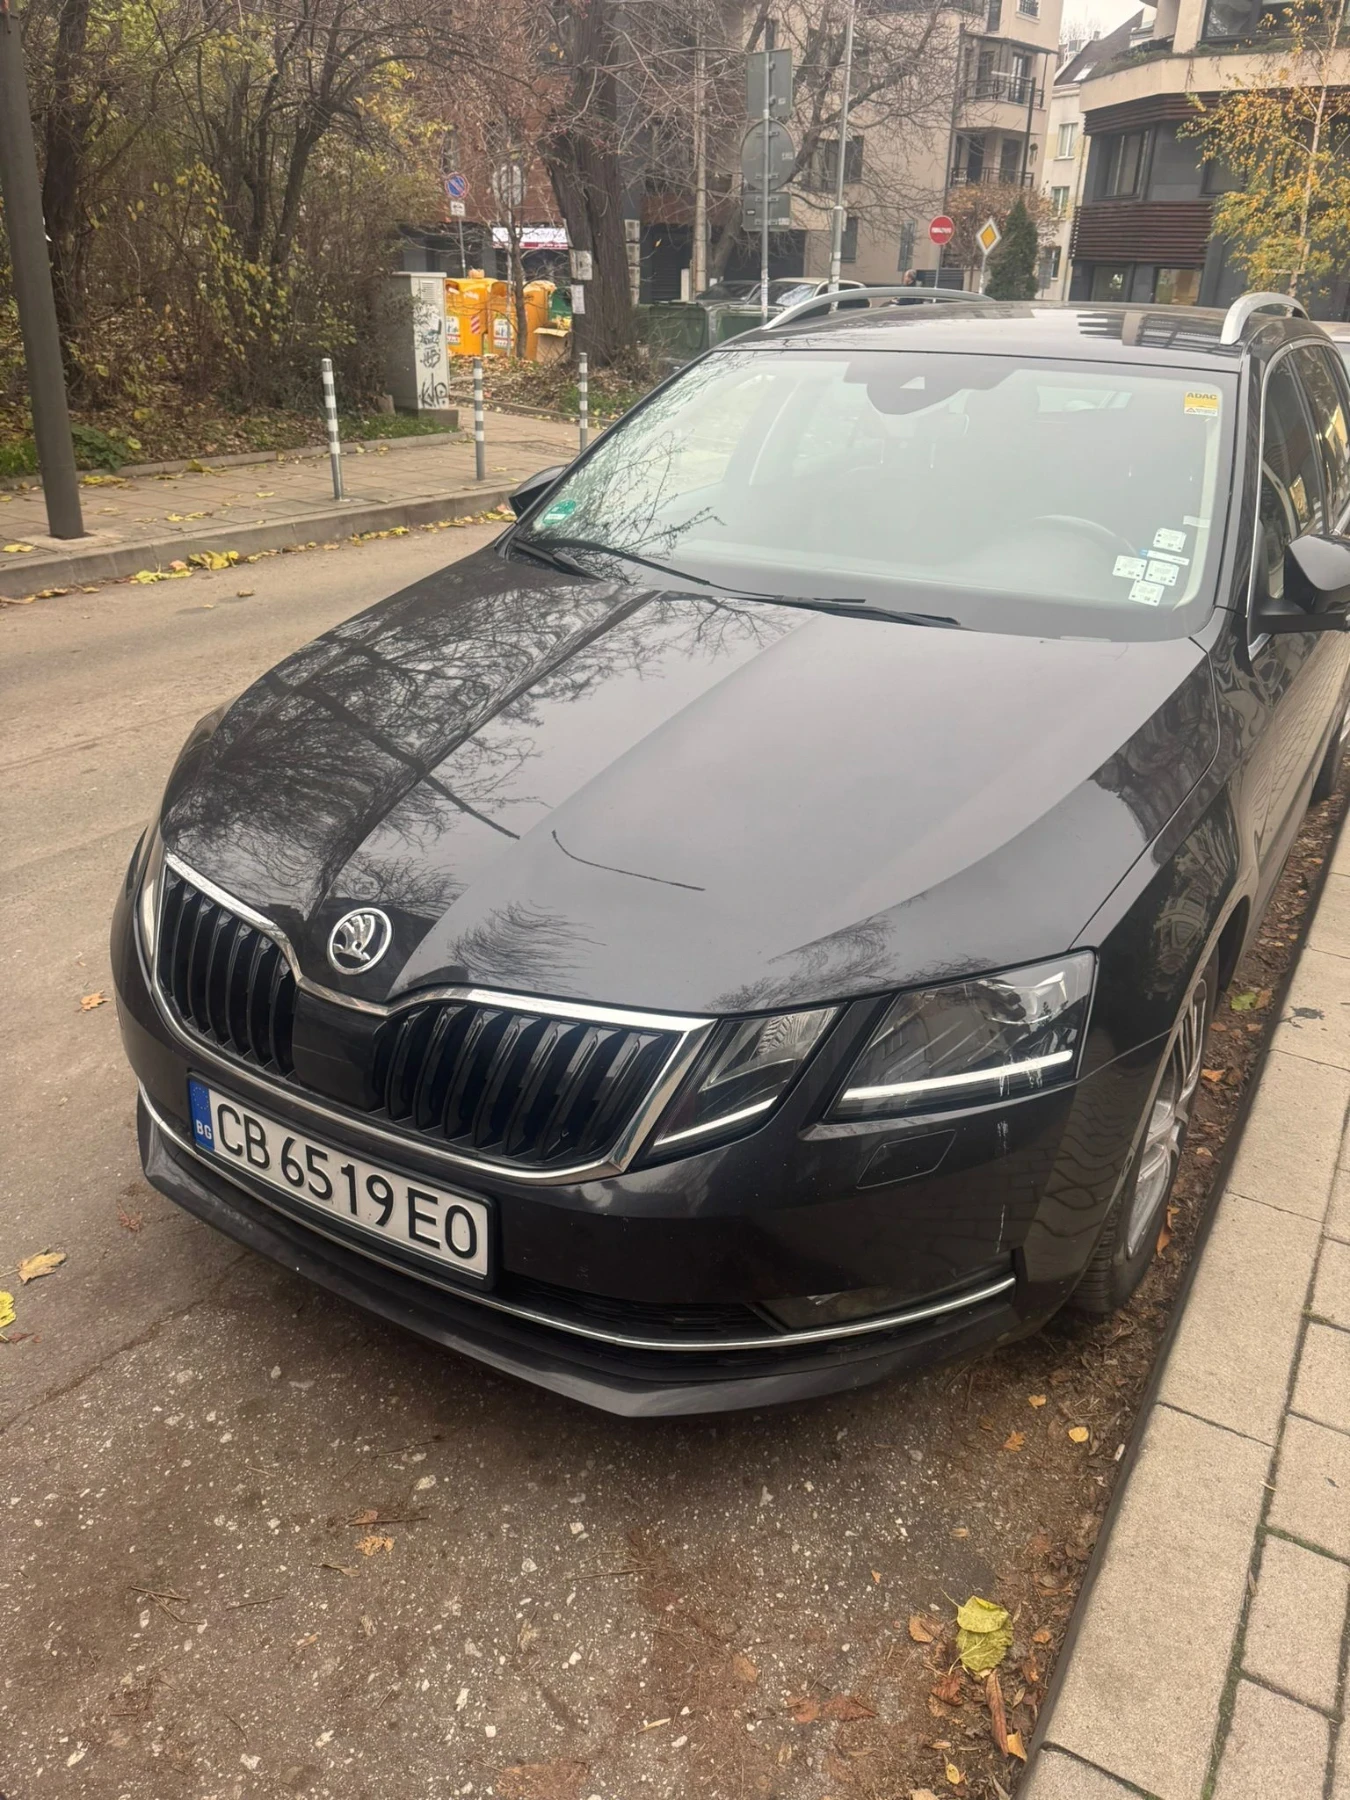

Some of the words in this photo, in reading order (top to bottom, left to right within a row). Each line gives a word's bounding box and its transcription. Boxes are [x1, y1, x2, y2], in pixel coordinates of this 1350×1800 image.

[1186, 392, 1217, 400] ADAC
[196, 1120, 212, 1140] BG
[217, 1103, 270, 1169] CB
[281, 1136, 394, 1227] 6519
